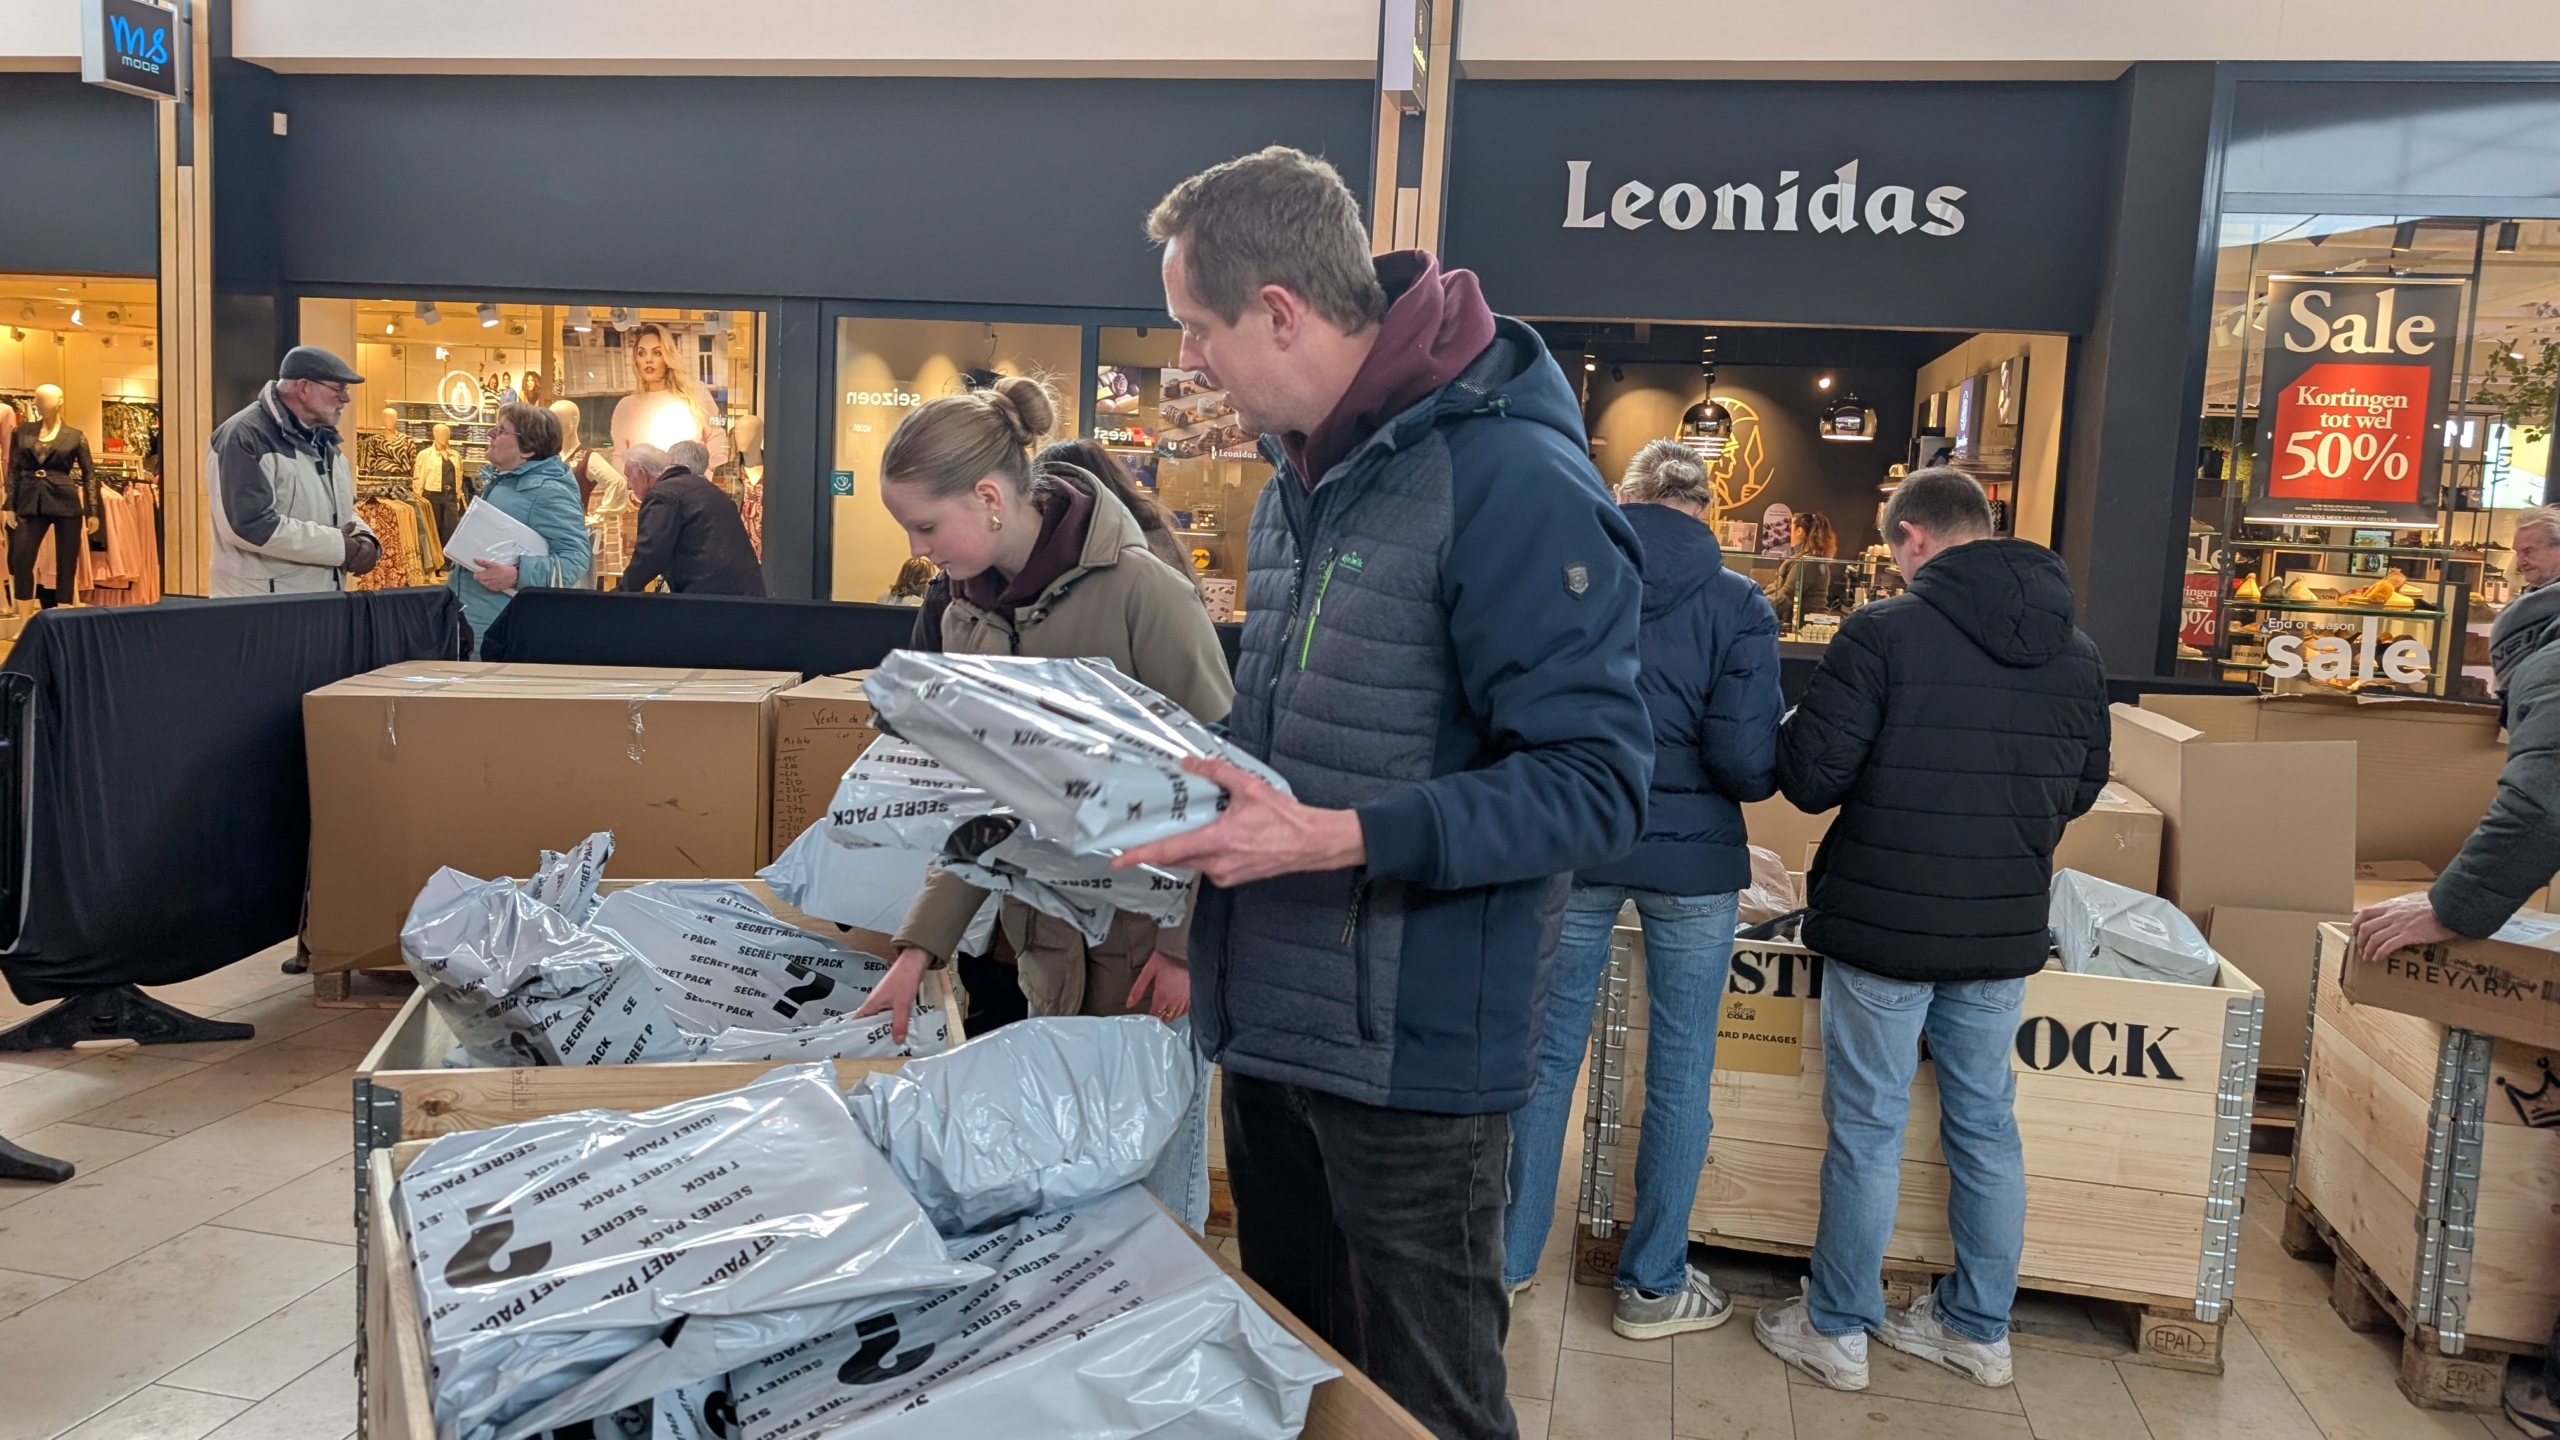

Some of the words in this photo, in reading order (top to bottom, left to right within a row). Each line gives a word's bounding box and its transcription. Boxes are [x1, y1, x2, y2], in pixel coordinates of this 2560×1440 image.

[1562, 158, 1968, 236] Leonidas
[2284, 288, 2435, 355] Sale
[2296, 386, 2408, 414] Kortingen
[2320, 412, 2351, 428] tot
[2355, 409, 2393, 429] wel
[1218, 449, 1258, 459] Leonidas
[2282, 430, 2409, 481] 50%
[2268, 617, 2292, 629] End
[2295, 619, 2308, 630] of
[2264, 616, 2432, 684] sale
[812, 708, 840, 726] Vente
[875, 754, 940, 769] SECRET
[833, 805, 879, 827] PACK
[882, 800, 950, 820] SECRET
[690, 934, 717, 946] PACK
[735, 922, 774, 936] SECRET
[690, 954, 730, 969] SECRET
[731, 964, 760, 977] PACK
[738, 946, 777, 961] SECRET
[815, 957, 845, 969] PACK
[684, 973, 713, 986] PACK
[2387, 958, 2524, 1002] FREYARA
[622, 995, 638, 1016] SE
[726, 1005, 755, 1018] PACK
[1727, 1007, 1756, 1016] KING
[560, 1005, 595, 1056] SECRET
[1716, 1031, 1740, 1039] ARD
[1743, 1033, 1797, 1044] PACKAGES
[471, 1142, 538, 1178] SECRET
[623, 1137, 670, 1161] PACK
[523, 1154, 572, 1180] PACK
[631, 1152, 695, 1188] SECRET
[680, 1165, 729, 1193] PACK
[416, 1175, 468, 1202] PACK
[531, 1172, 590, 1206] SECRE
[578, 1183, 628, 1211] PACK
[690, 1185, 754, 1220] SECRET
[580, 1204, 649, 1246] SECRET
[637, 1219, 688, 1249] PACK
[1002, 1252, 1061, 1283] SECRET
[1050, 1256, 1093, 1285] PACK
[958, 1283, 1001, 1316] PACK
[961, 1299, 1023, 1339] SECRET
[2154, 1330, 2195, 1353] EPAL
[756, 1358, 824, 1396] SECRET
